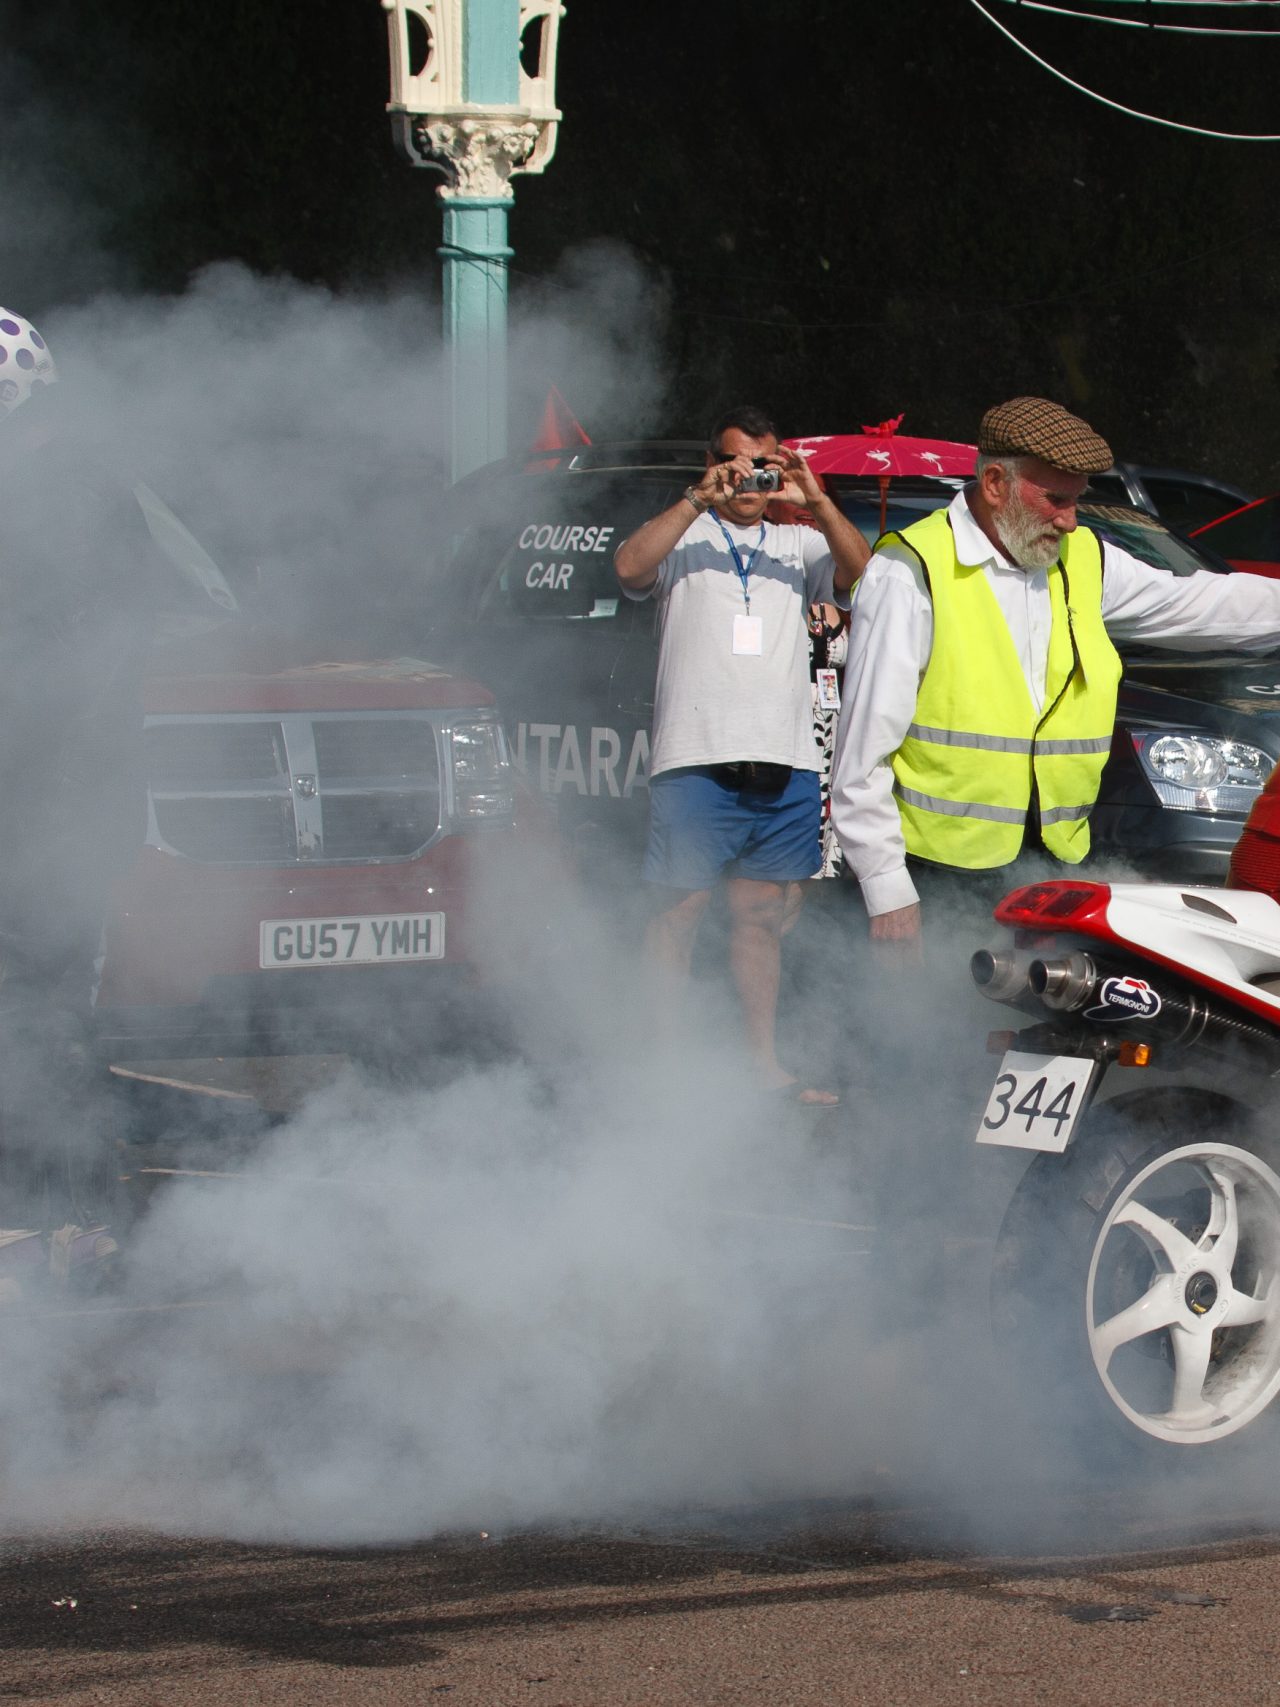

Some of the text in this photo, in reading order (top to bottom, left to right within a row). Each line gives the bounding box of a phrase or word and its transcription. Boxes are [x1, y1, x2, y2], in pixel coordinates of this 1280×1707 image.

[519, 525, 614, 552] COURSE
[525, 562, 574, 590] CAR
[273, 919, 432, 961] GU57 YMH
[1108, 993, 1150, 1013] TERMIGNONI
[983, 1073, 1076, 1138] 344
